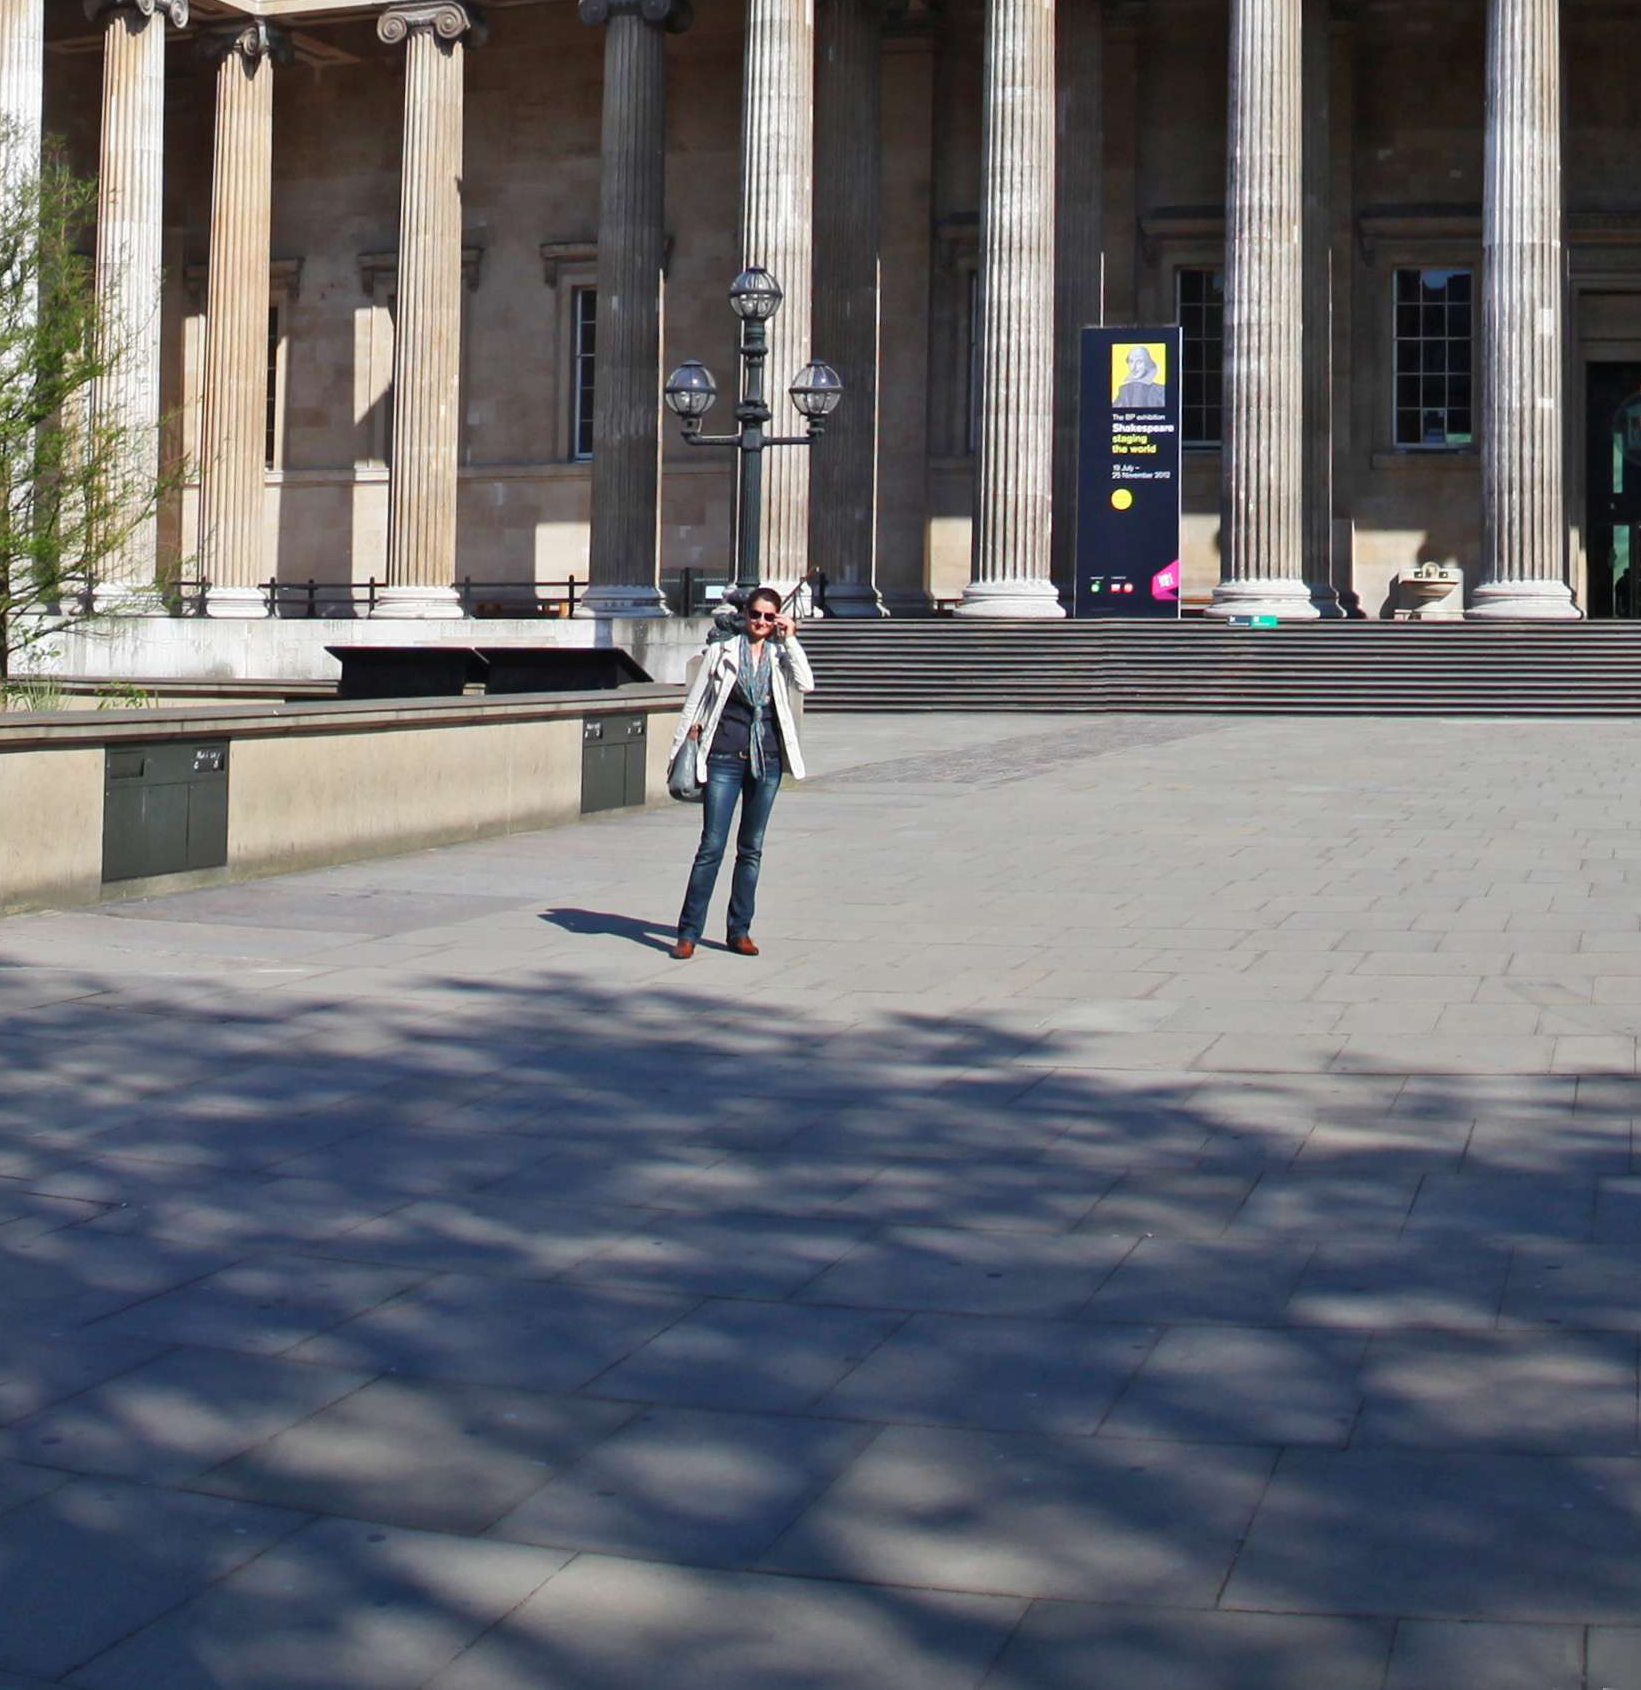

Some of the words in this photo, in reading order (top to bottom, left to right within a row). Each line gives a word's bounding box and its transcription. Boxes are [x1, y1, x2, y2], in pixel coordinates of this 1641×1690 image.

[1112, 413, 1124, 421] The
[1136, 413, 1166, 421] exhibition
[1112, 423, 1175, 434] Shakespeare
[1112, 434, 1148, 444] staging
[1112, 444, 1128, 454] the
[1129, 444, 1157, 454] world
